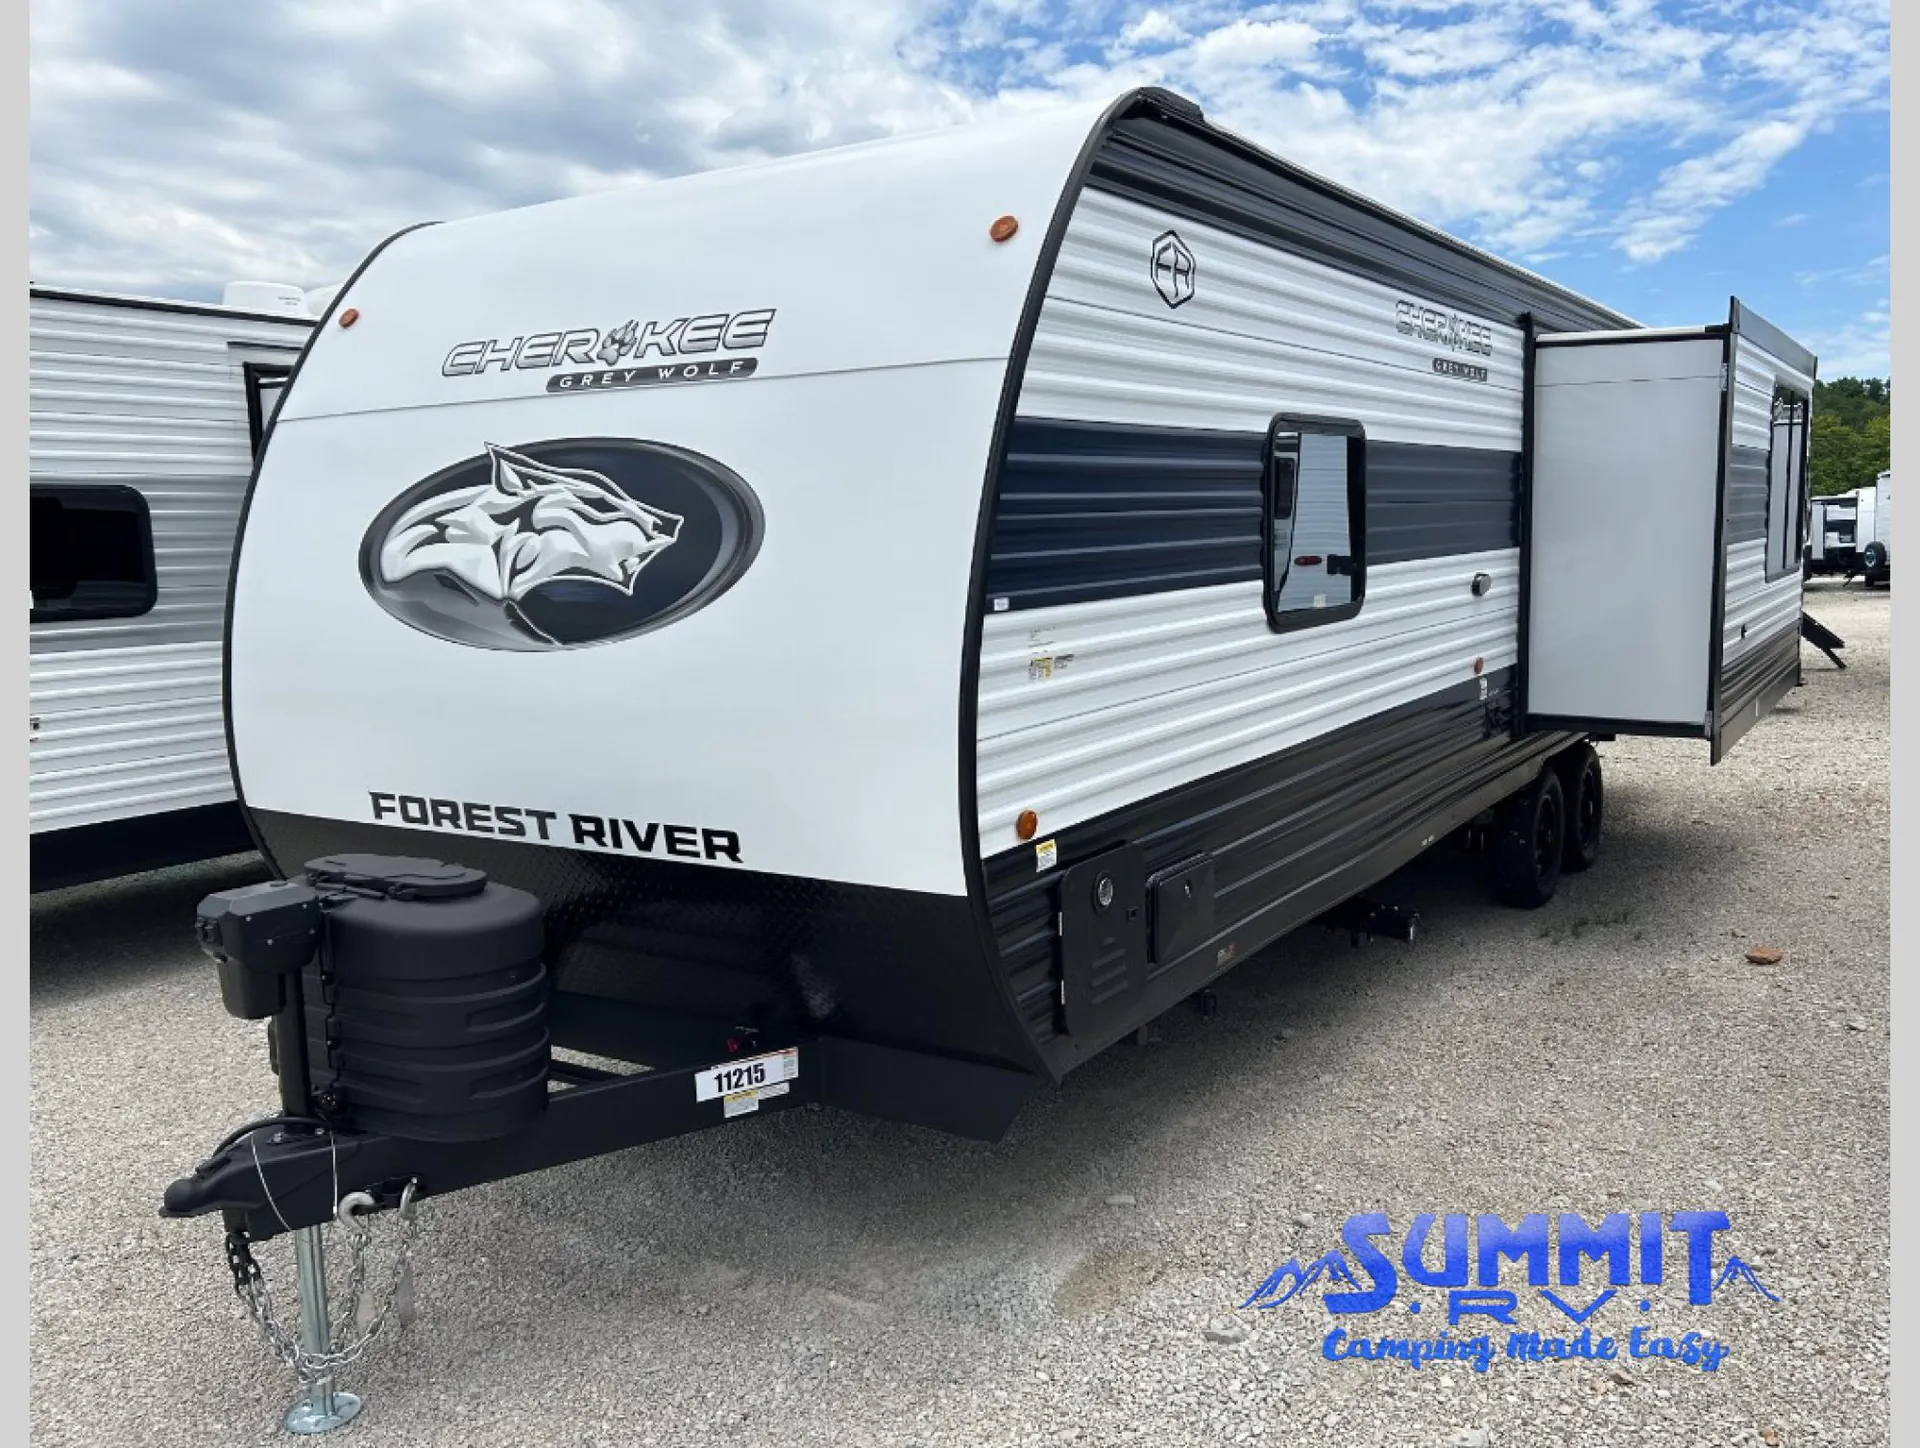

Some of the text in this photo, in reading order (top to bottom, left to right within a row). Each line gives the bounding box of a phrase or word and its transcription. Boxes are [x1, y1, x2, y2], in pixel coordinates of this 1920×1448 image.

[559, 361, 744, 388] GREY WOLF
[368, 790, 744, 864] FOREST RIVER
[714, 1063, 766, 1093] 11215
